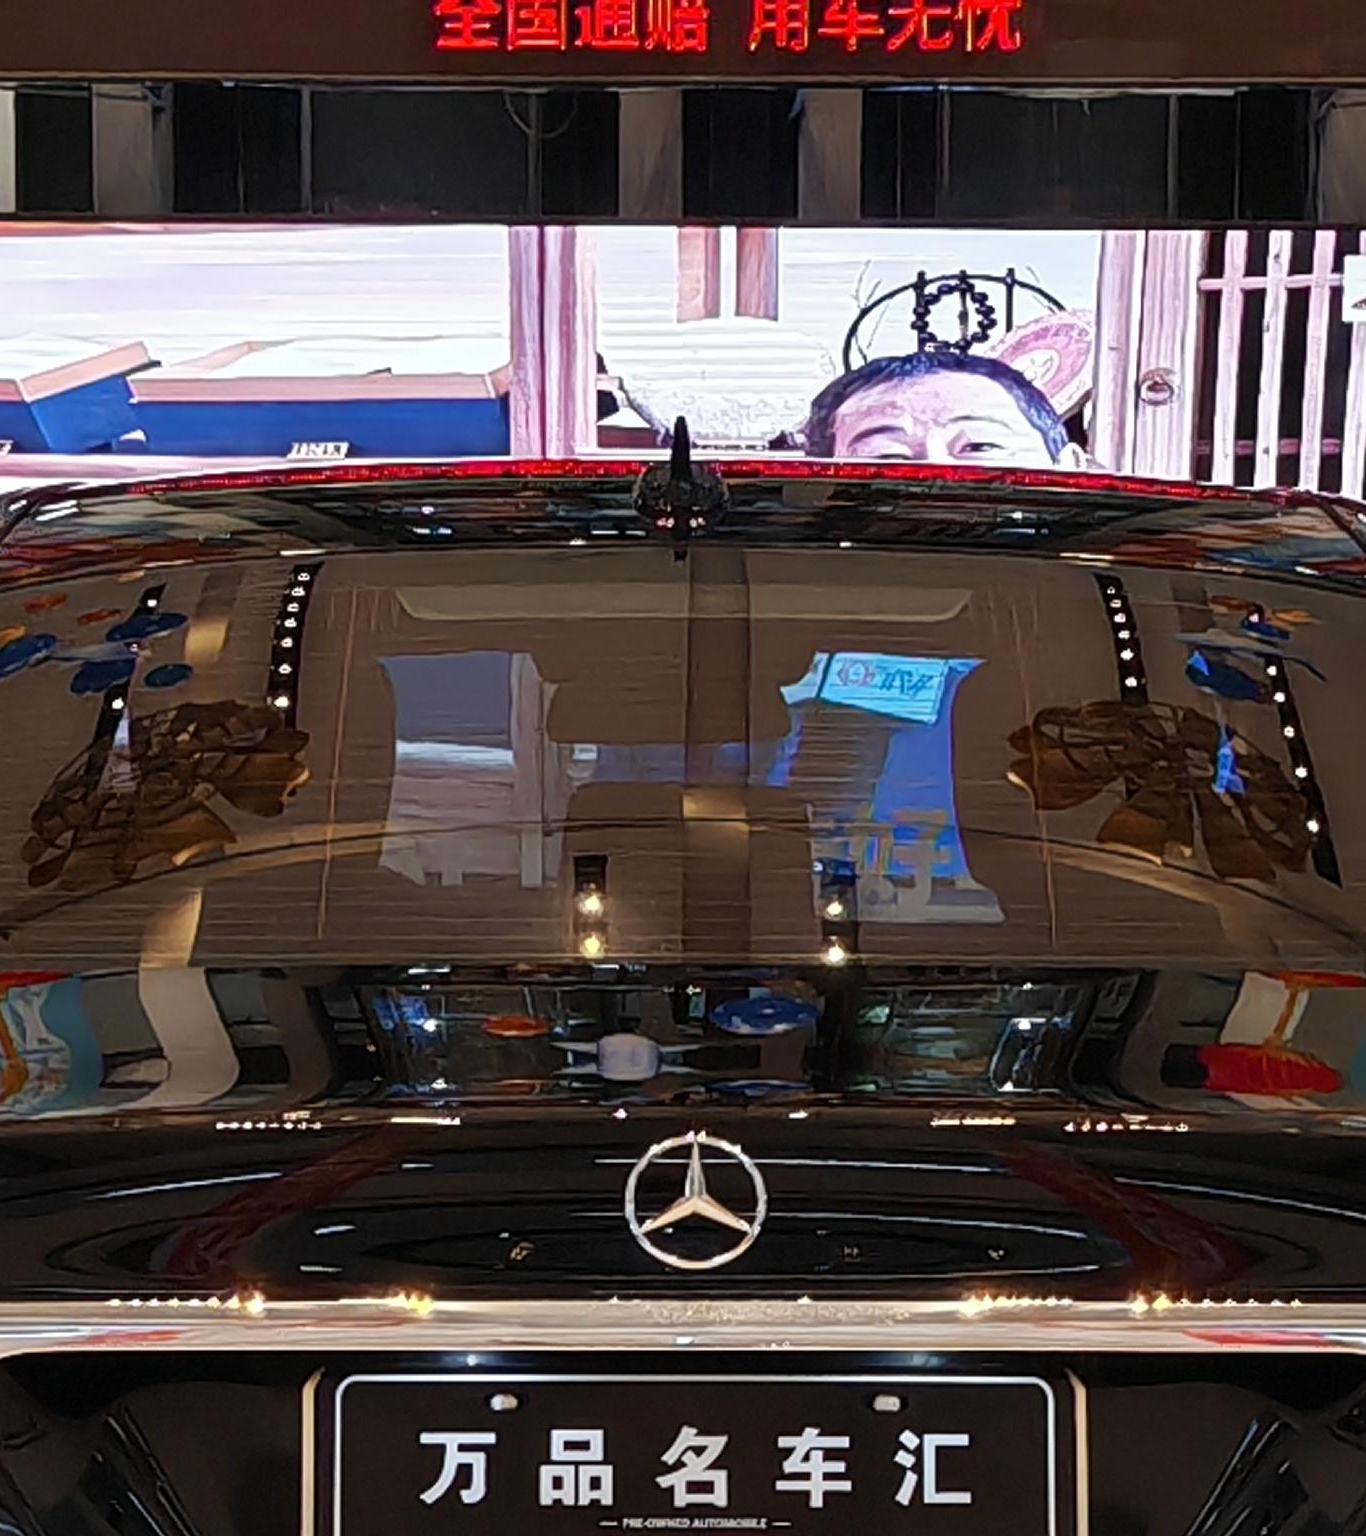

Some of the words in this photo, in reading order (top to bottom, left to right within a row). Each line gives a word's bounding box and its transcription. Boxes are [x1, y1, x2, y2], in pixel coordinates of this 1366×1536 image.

[434, 0, 709, 52] 全国通赔
[747, 0, 1022, 52] 用车无忧
[419, 1425, 972, 1508] 万品名车汇
